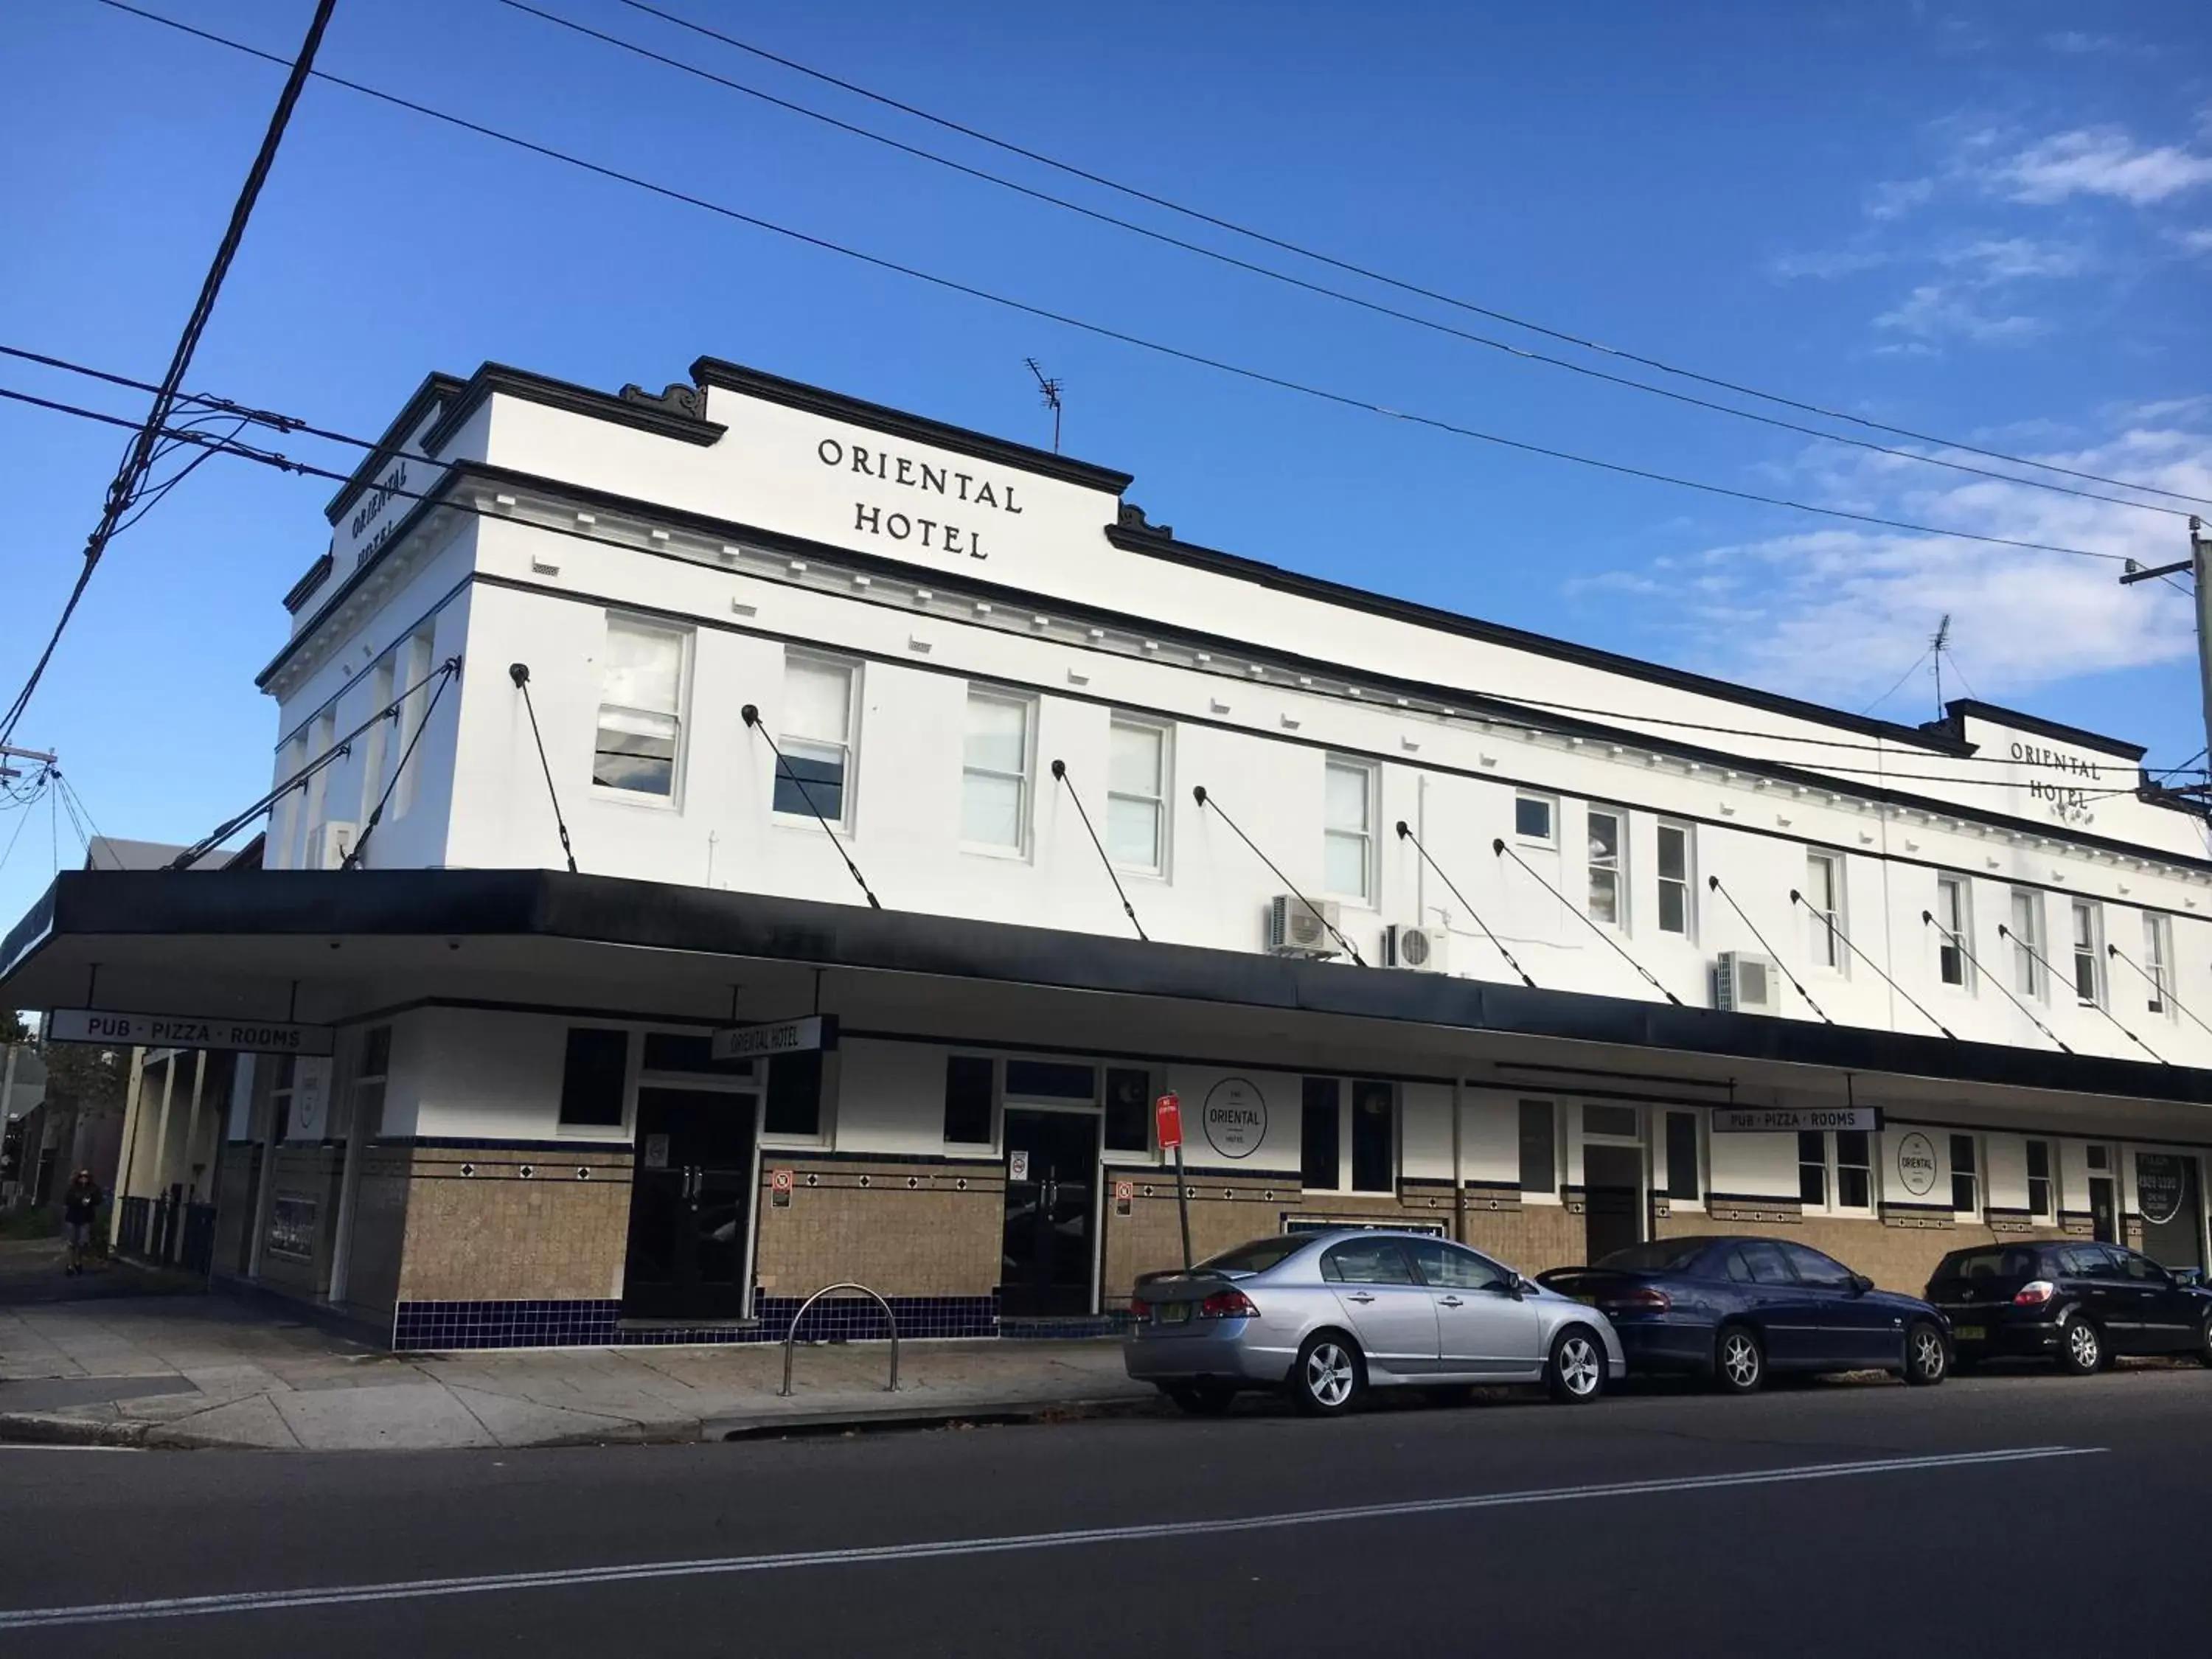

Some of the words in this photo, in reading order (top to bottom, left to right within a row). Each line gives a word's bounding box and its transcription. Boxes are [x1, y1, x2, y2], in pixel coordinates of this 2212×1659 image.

[818, 439, 1023, 513] ORIENTAL
[352, 462, 406, 540] ORIENTAL
[855, 503, 987, 560] HOTEL
[2011, 742, 2100, 780] ORIENTAL
[2031, 780, 2087, 809] HOTEL
[88, 1018, 130, 1037] PUB
[152, 1022, 209, 1041] PIZZA
[231, 1027, 301, 1048] ROOMS
[731, 1030, 768, 1052] ORIENTAL
[772, 1026, 798, 1048] HOTEL
[1210, 1108, 1260, 1125] ORIENTAL
[1731, 1114, 1753, 1127] PUB
[1764, 1113, 1799, 1127] PIZZA
[1811, 1112, 1855, 1126] ROOMS
